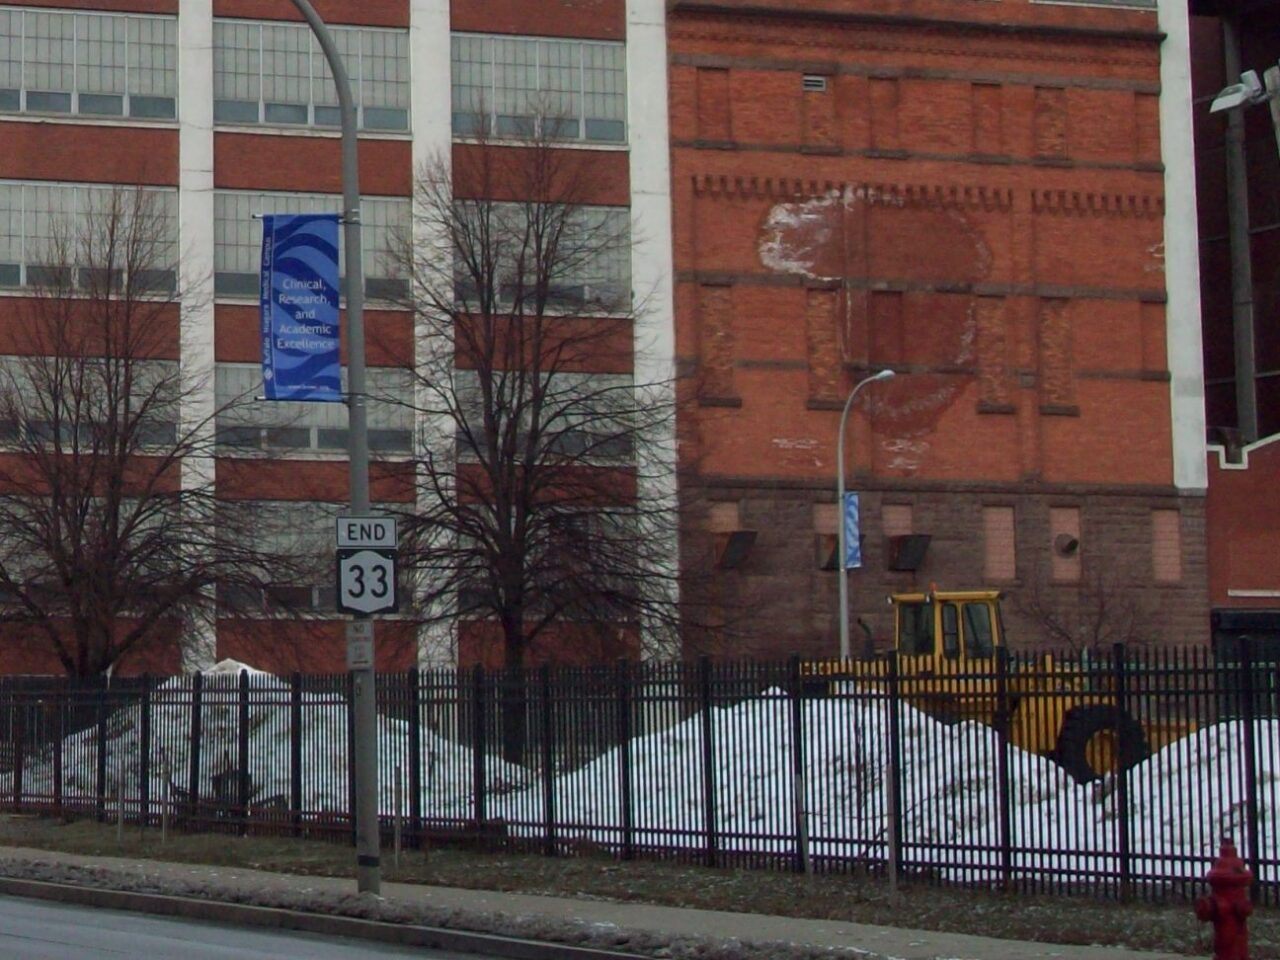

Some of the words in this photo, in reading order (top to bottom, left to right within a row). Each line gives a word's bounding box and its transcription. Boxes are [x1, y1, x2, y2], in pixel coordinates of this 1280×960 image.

[282, 277, 327, 291] Clinical,
[279, 294, 331, 306] Research,
[295, 309, 316, 320] and
[279, 324, 332, 335] Academic
[277, 339, 335, 350] Excellence
[348, 523, 385, 541] END
[348, 564, 388, 598] 33
